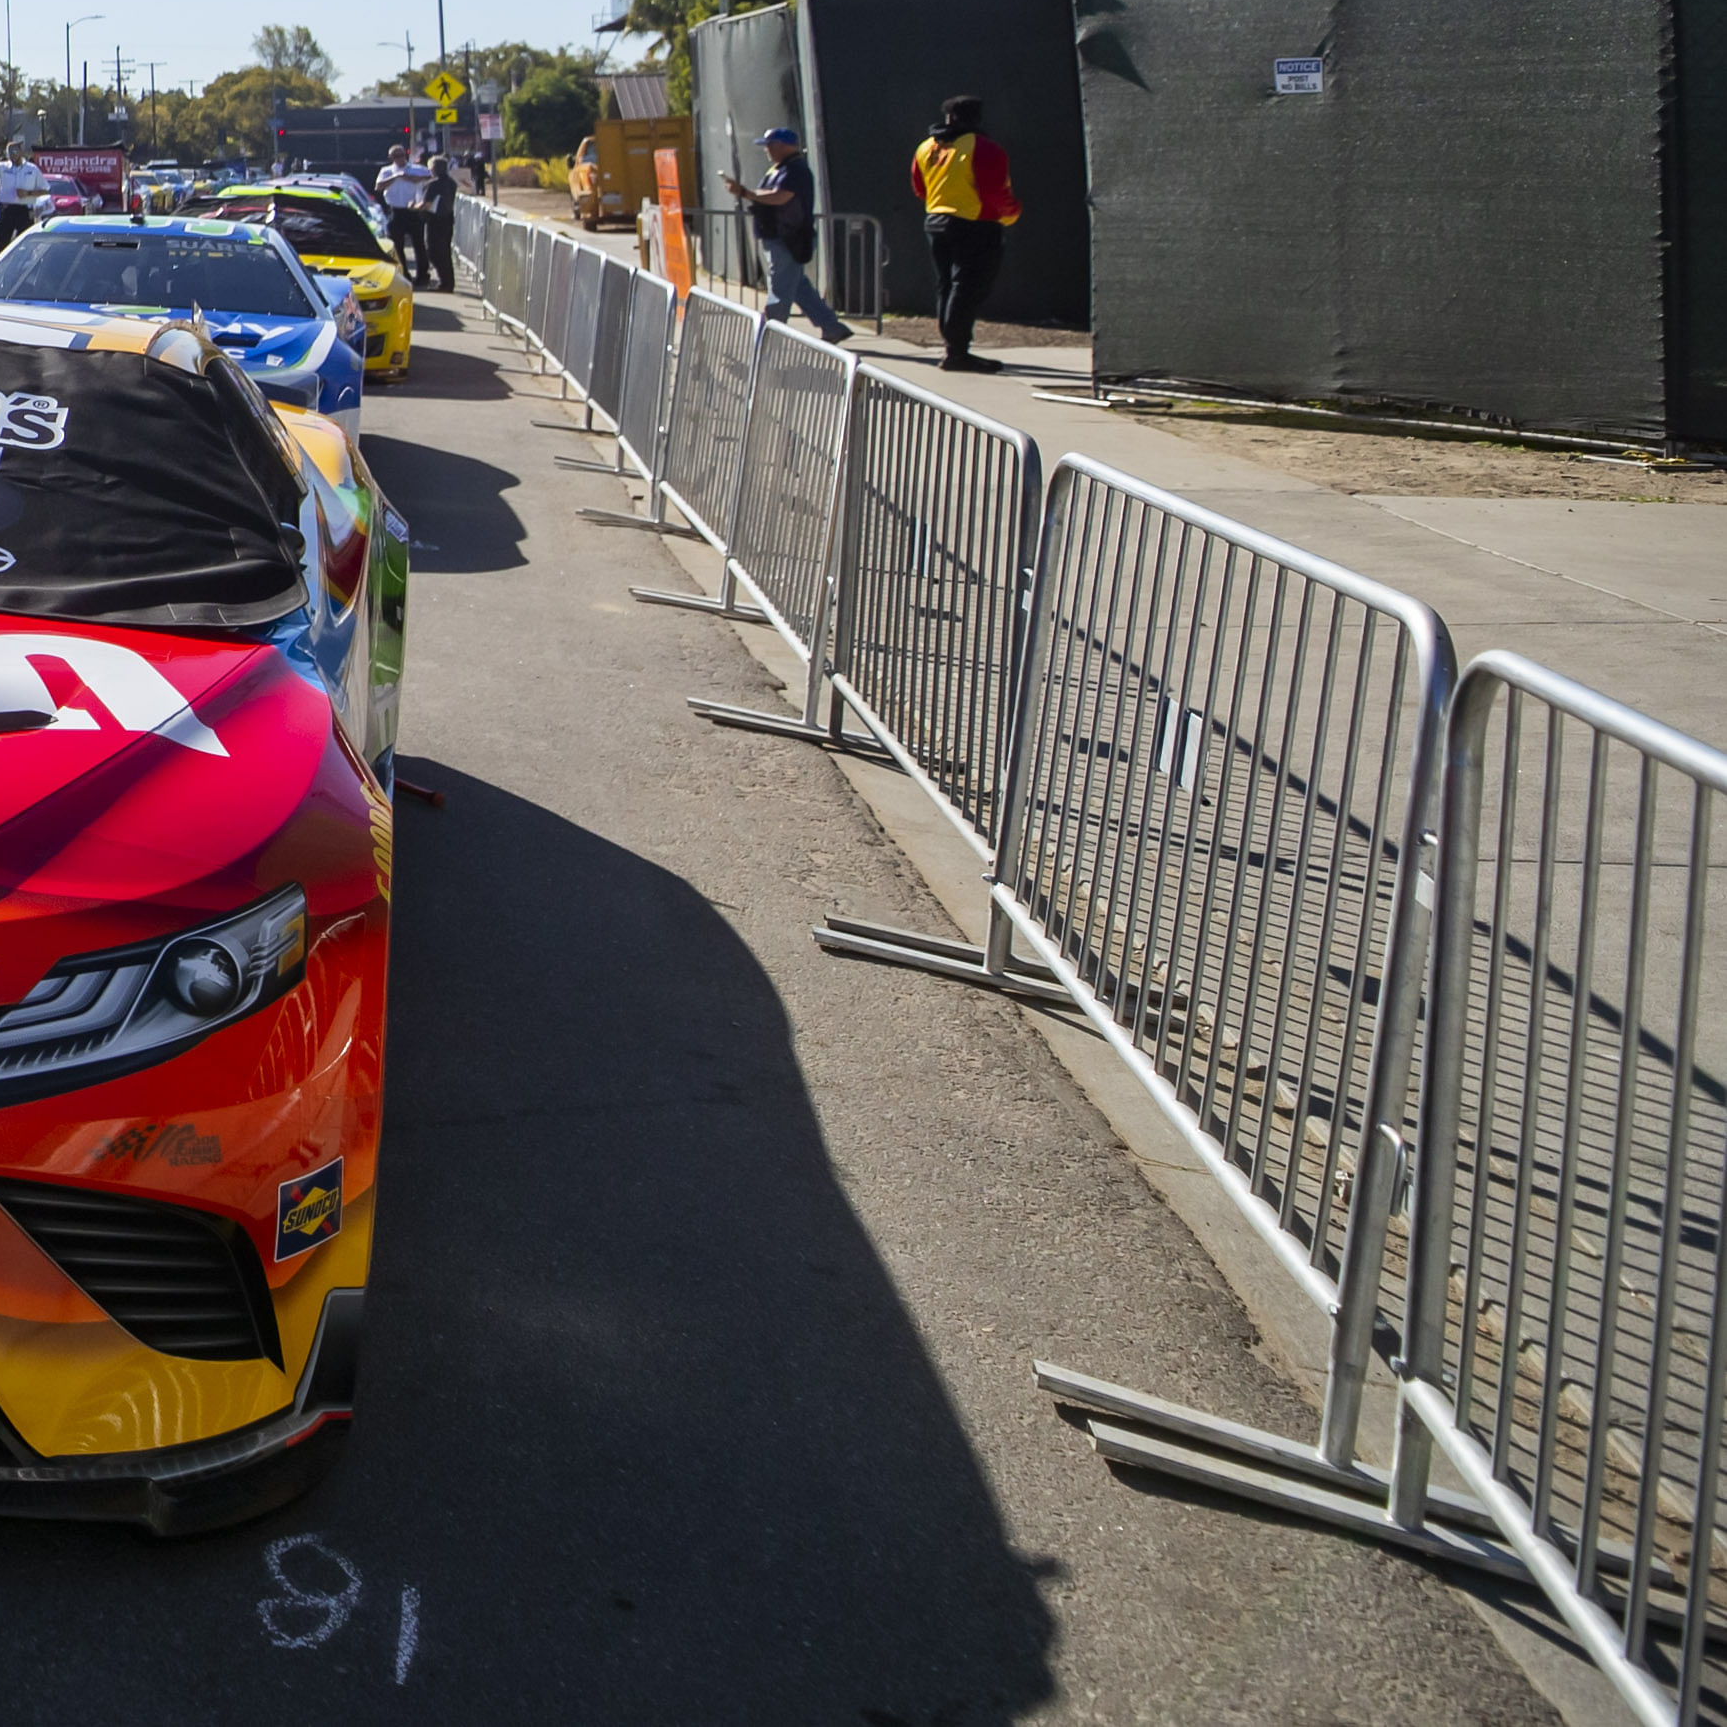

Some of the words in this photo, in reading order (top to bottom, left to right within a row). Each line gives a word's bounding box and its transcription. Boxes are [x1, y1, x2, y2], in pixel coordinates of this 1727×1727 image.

[1278, 62, 1317, 72] NOTICE
[1295, 82, 1318, 90] BILLS
[38, 155, 117, 166] Mahindra
[285, 1188, 338, 1233] SUNOCO
